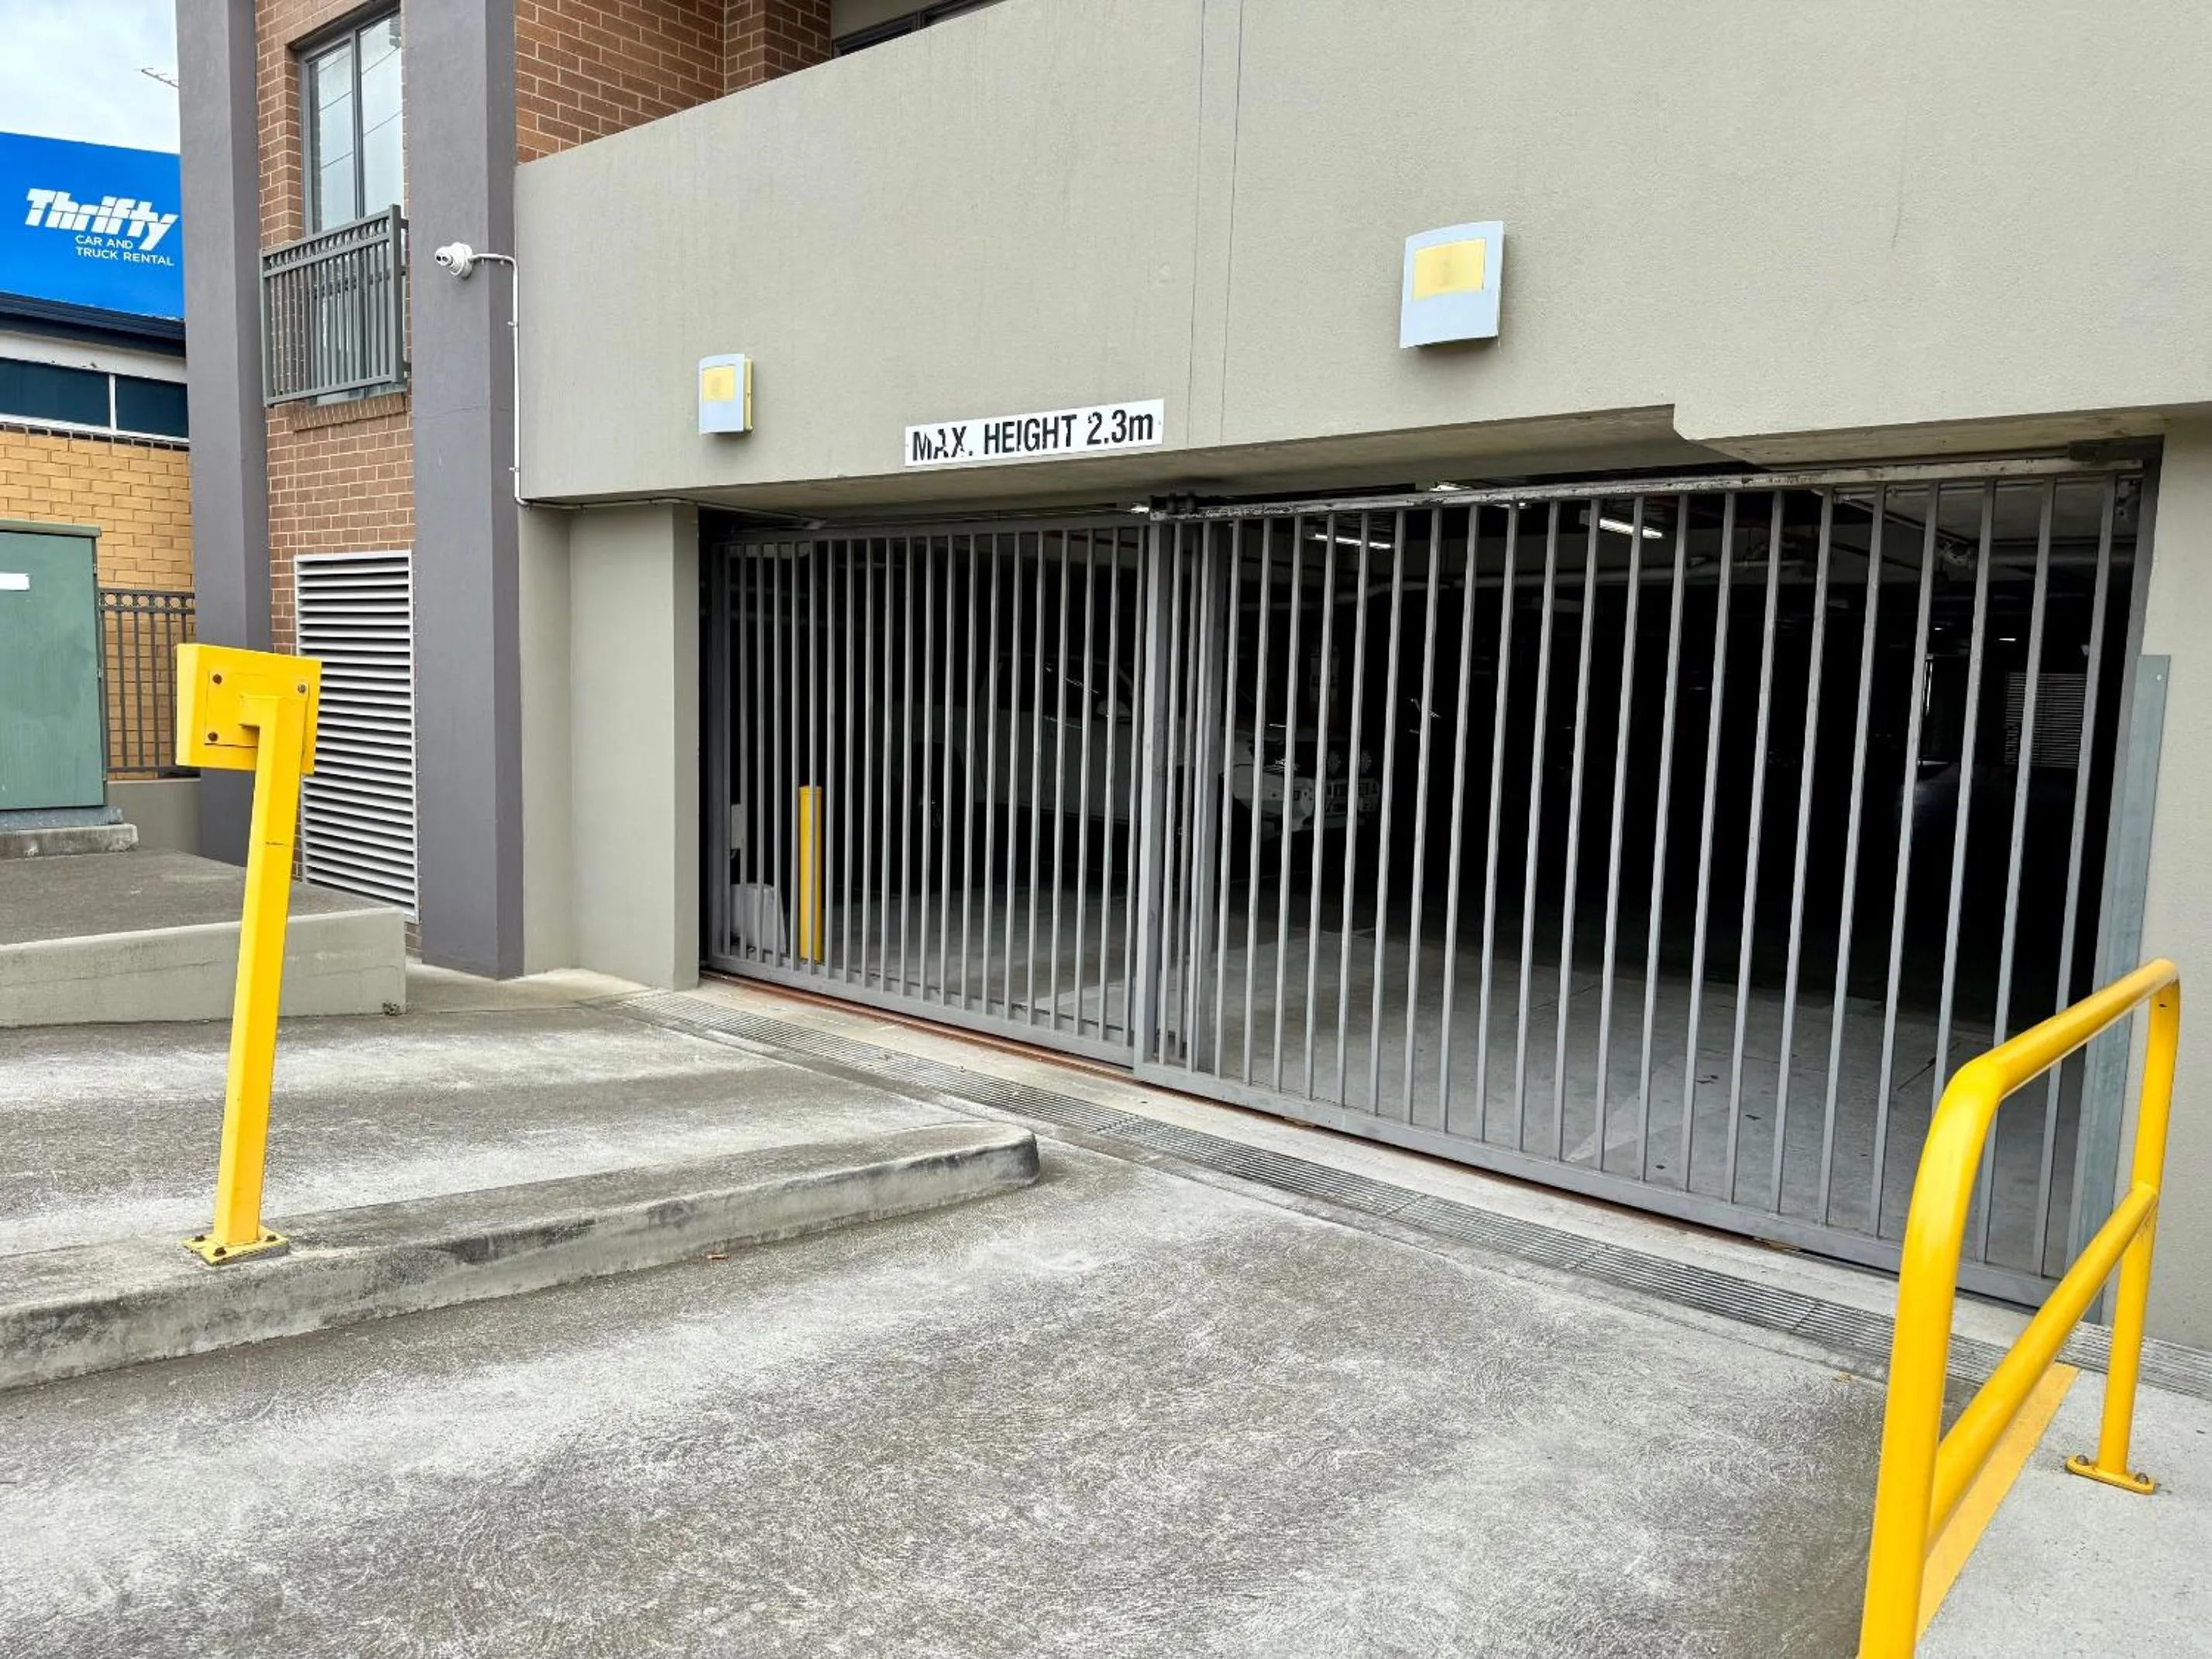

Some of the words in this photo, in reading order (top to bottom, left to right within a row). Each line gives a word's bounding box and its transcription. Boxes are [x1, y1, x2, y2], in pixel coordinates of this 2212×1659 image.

[25, 188, 179, 251] Thrifty
[75, 235, 102, 246] CAR
[106, 238, 133, 249] AND
[76, 246, 118, 260] TRUCK
[123, 252, 174, 266] RENTAL
[912, 426, 974, 461] MAX.
[984, 414, 1077, 455] HEIGHT
[1086, 409, 1153, 445] 2.3m
